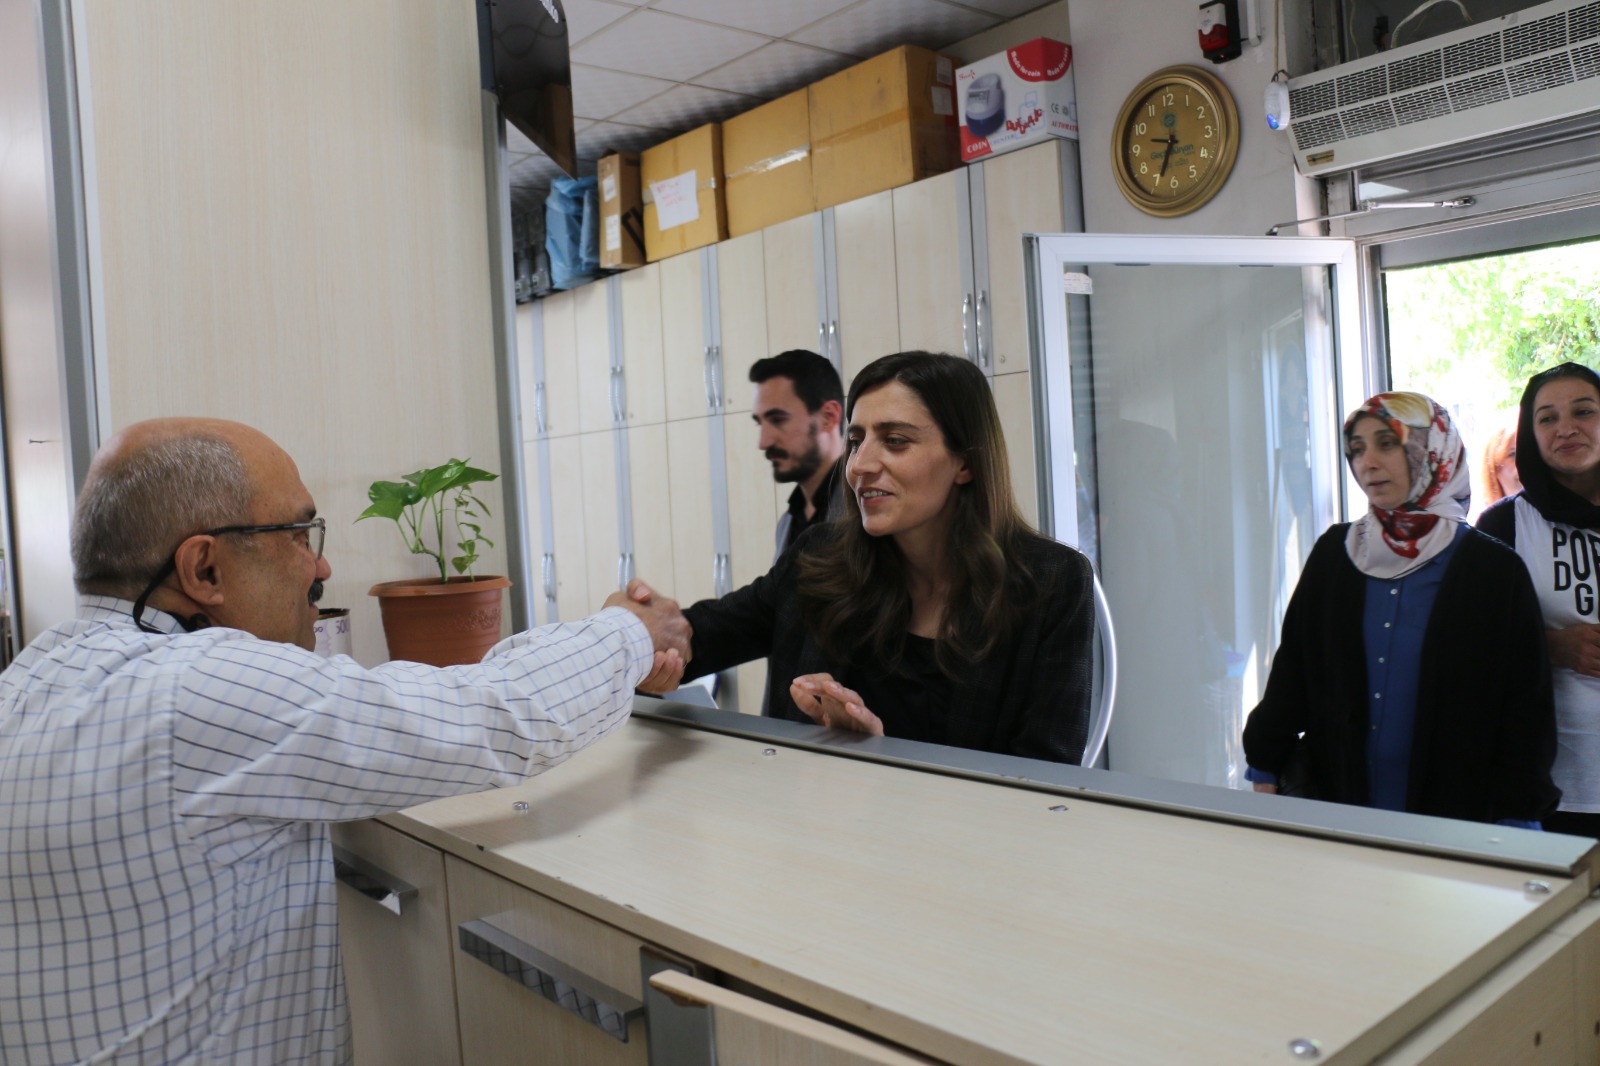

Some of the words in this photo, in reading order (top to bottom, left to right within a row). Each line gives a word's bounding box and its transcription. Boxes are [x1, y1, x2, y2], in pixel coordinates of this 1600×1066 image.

[1162, 93, 1174, 107] 12
[1148, 105, 1155, 117] 11
[1197, 106, 1205, 119] 2
[1135, 122, 1147, 136] 10
[1204, 125, 1213, 138] 3
[966, 140, 988, 153] COIN
[1132, 144, 1141, 156] 9
[1200, 146, 1208, 158] 4
[1140, 162, 1148, 174] 8
[1189, 165, 1197, 178] 5
[1152, 173, 1160, 186] 7
[1170, 176, 1179, 188] 6
